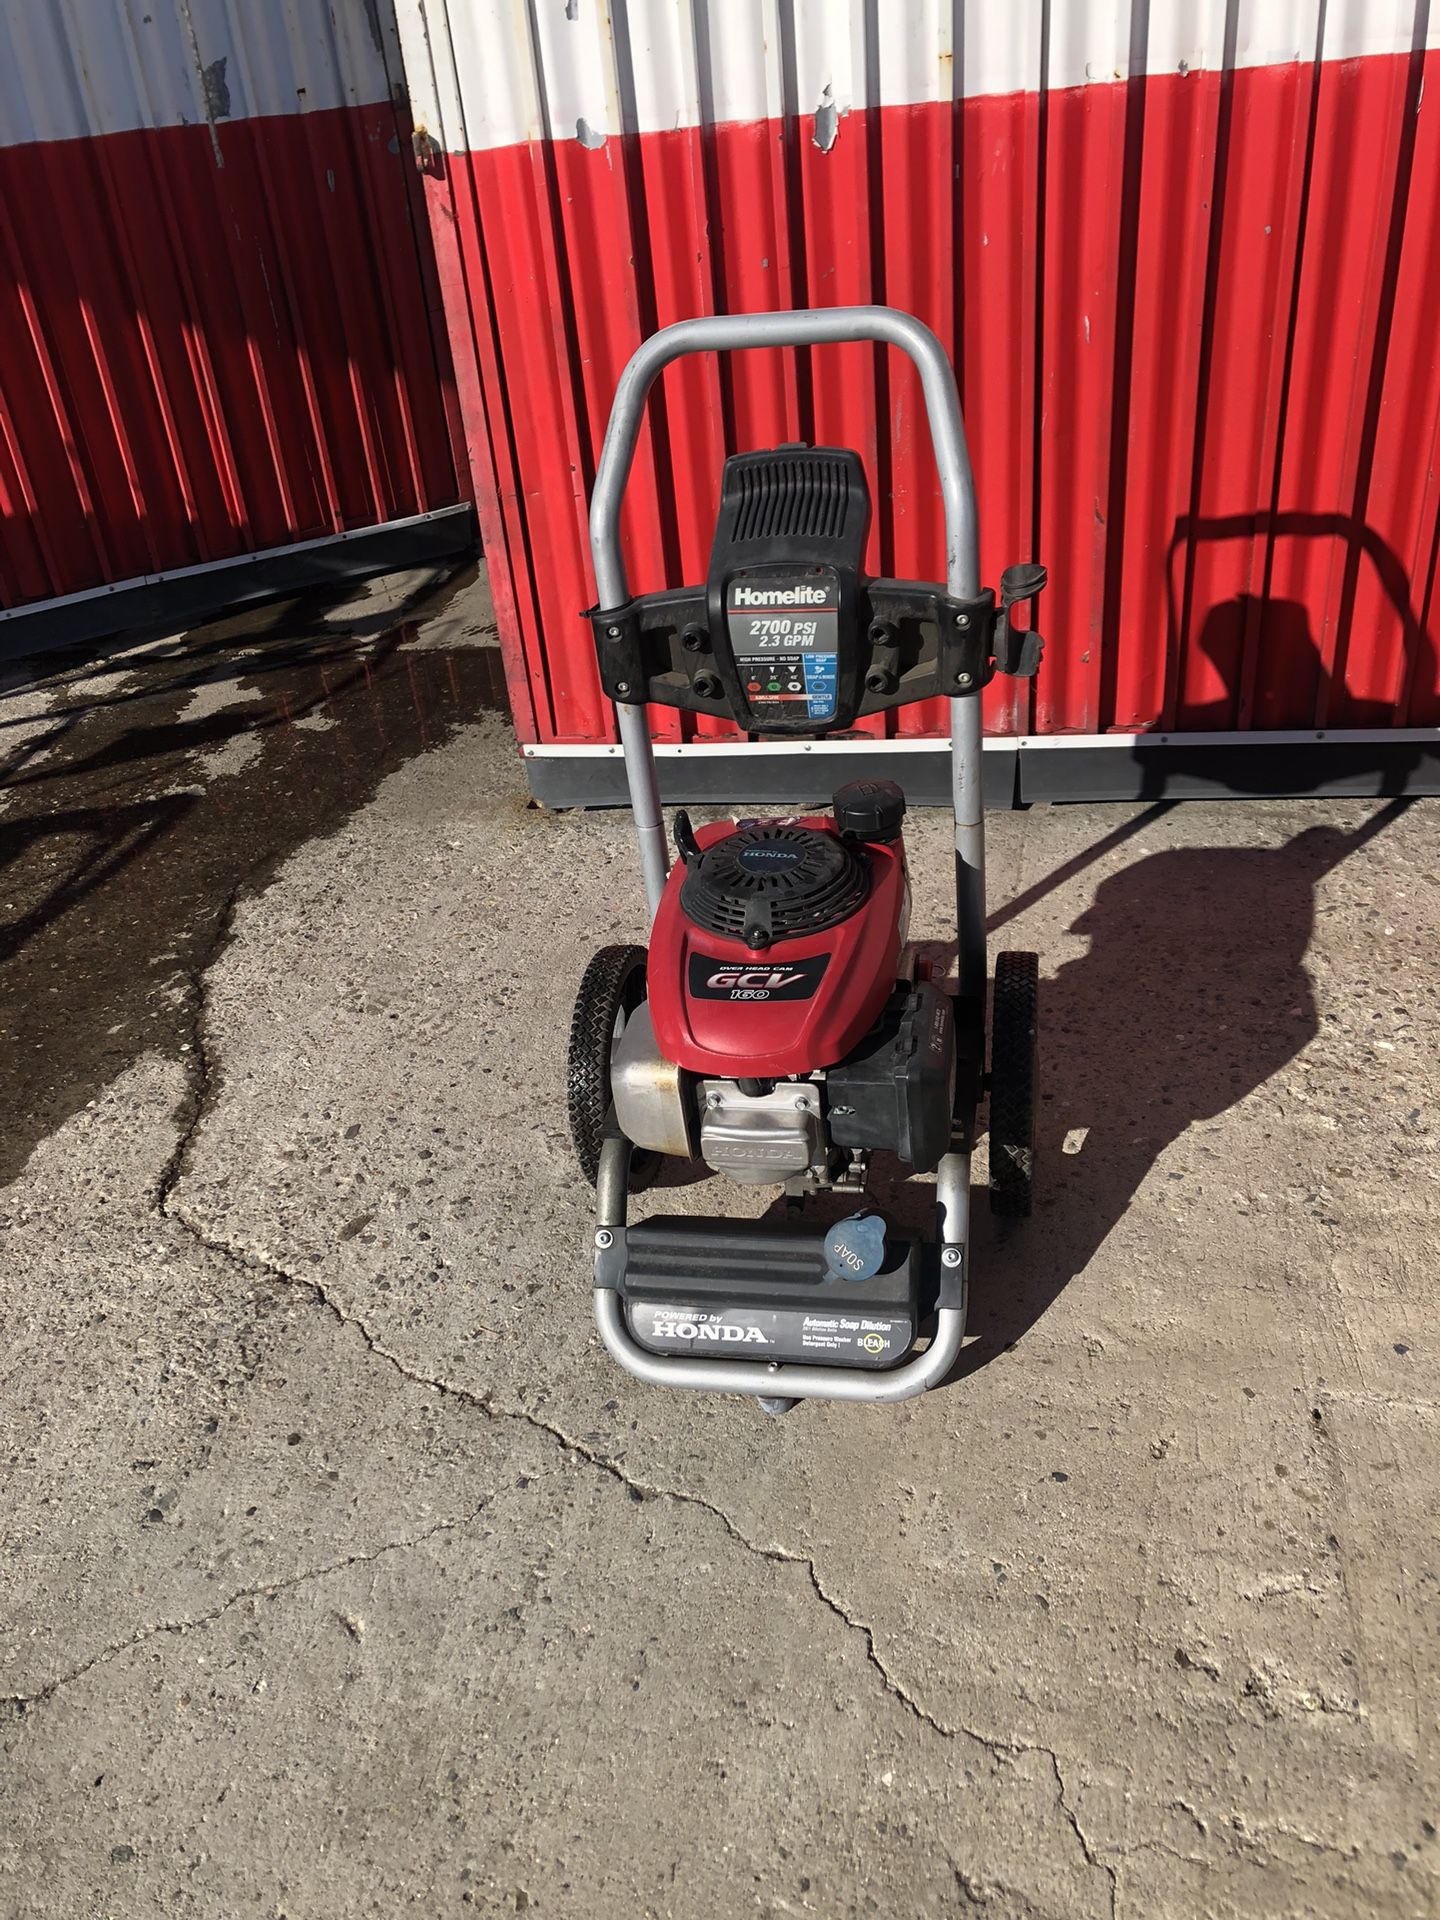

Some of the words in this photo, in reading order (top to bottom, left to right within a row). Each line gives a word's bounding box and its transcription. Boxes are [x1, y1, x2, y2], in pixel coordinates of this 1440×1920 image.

[734, 585, 827, 606] Homelite
[749, 620, 792, 635] 2700
[793, 622, 817, 635] PSI
[759, 635, 781, 647] 2.3
[783, 635, 815, 647] GPM
[743, 851, 798, 859] HONDA
[706, 973, 808, 989] GCV
[730, 989, 770, 1000] 160
[711, 1146, 803, 1160] HONDA
[833, 1243, 864, 1271] SOAP
[654, 1310, 708, 1322] POWERED
[709, 1314, 723, 1324] by
[803, 1316, 839, 1329] Automatic
[839, 1318, 860, 1331] Soap
[860, 1320, 892, 1332] Dilution
[652, 1321, 769, 1344] HONDA
[857, 1338, 891, 1349] BLEACH
